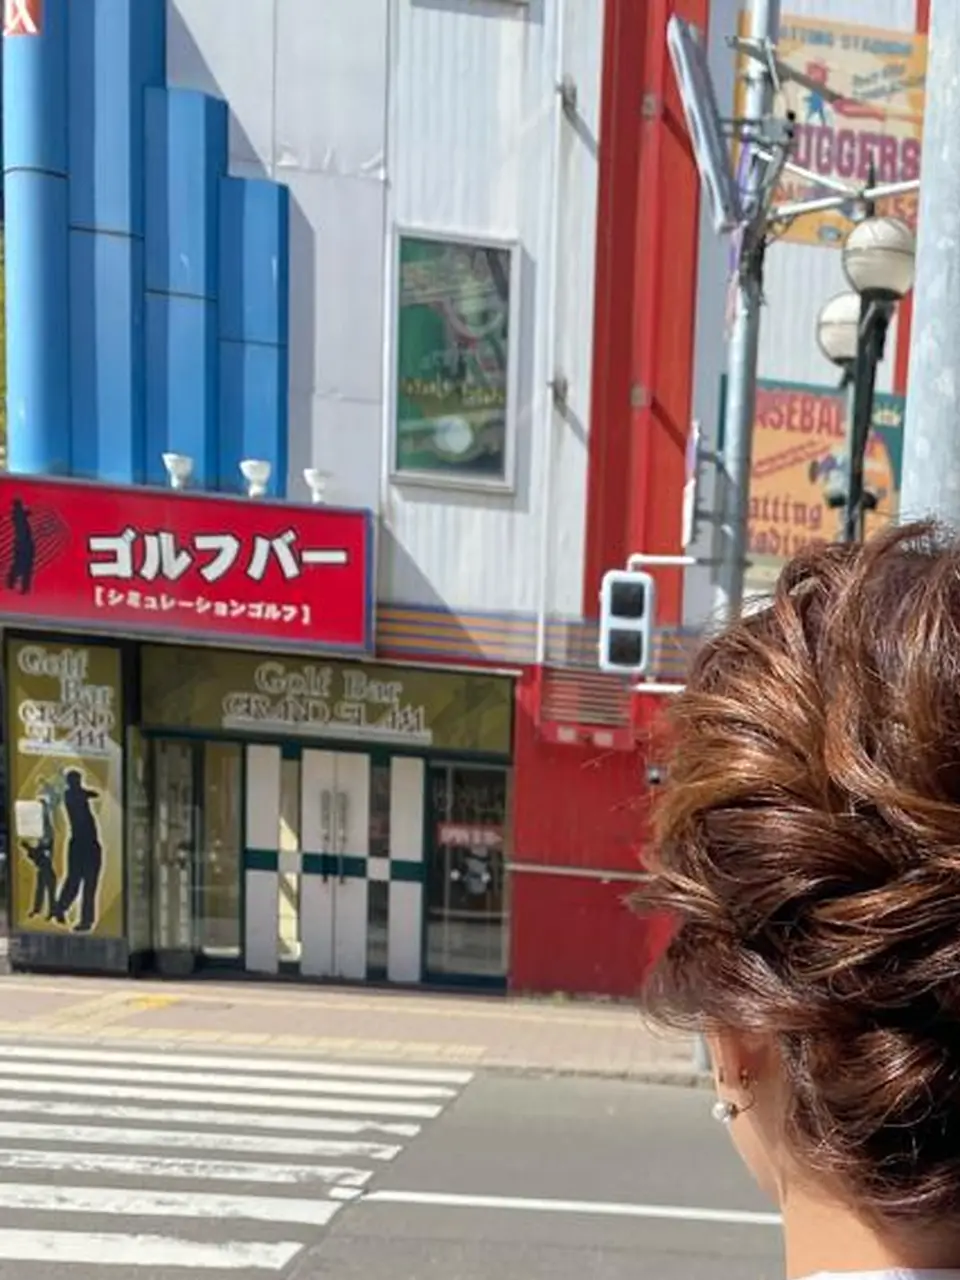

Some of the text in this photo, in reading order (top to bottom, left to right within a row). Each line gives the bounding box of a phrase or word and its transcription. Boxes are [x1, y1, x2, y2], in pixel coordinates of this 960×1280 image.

[792, 121, 922, 183] UGGERS
[88, 528, 349, 584] ゴルフバー
[17, 645, 89, 682] Golf
[254, 661, 403, 703] Golf Bar
